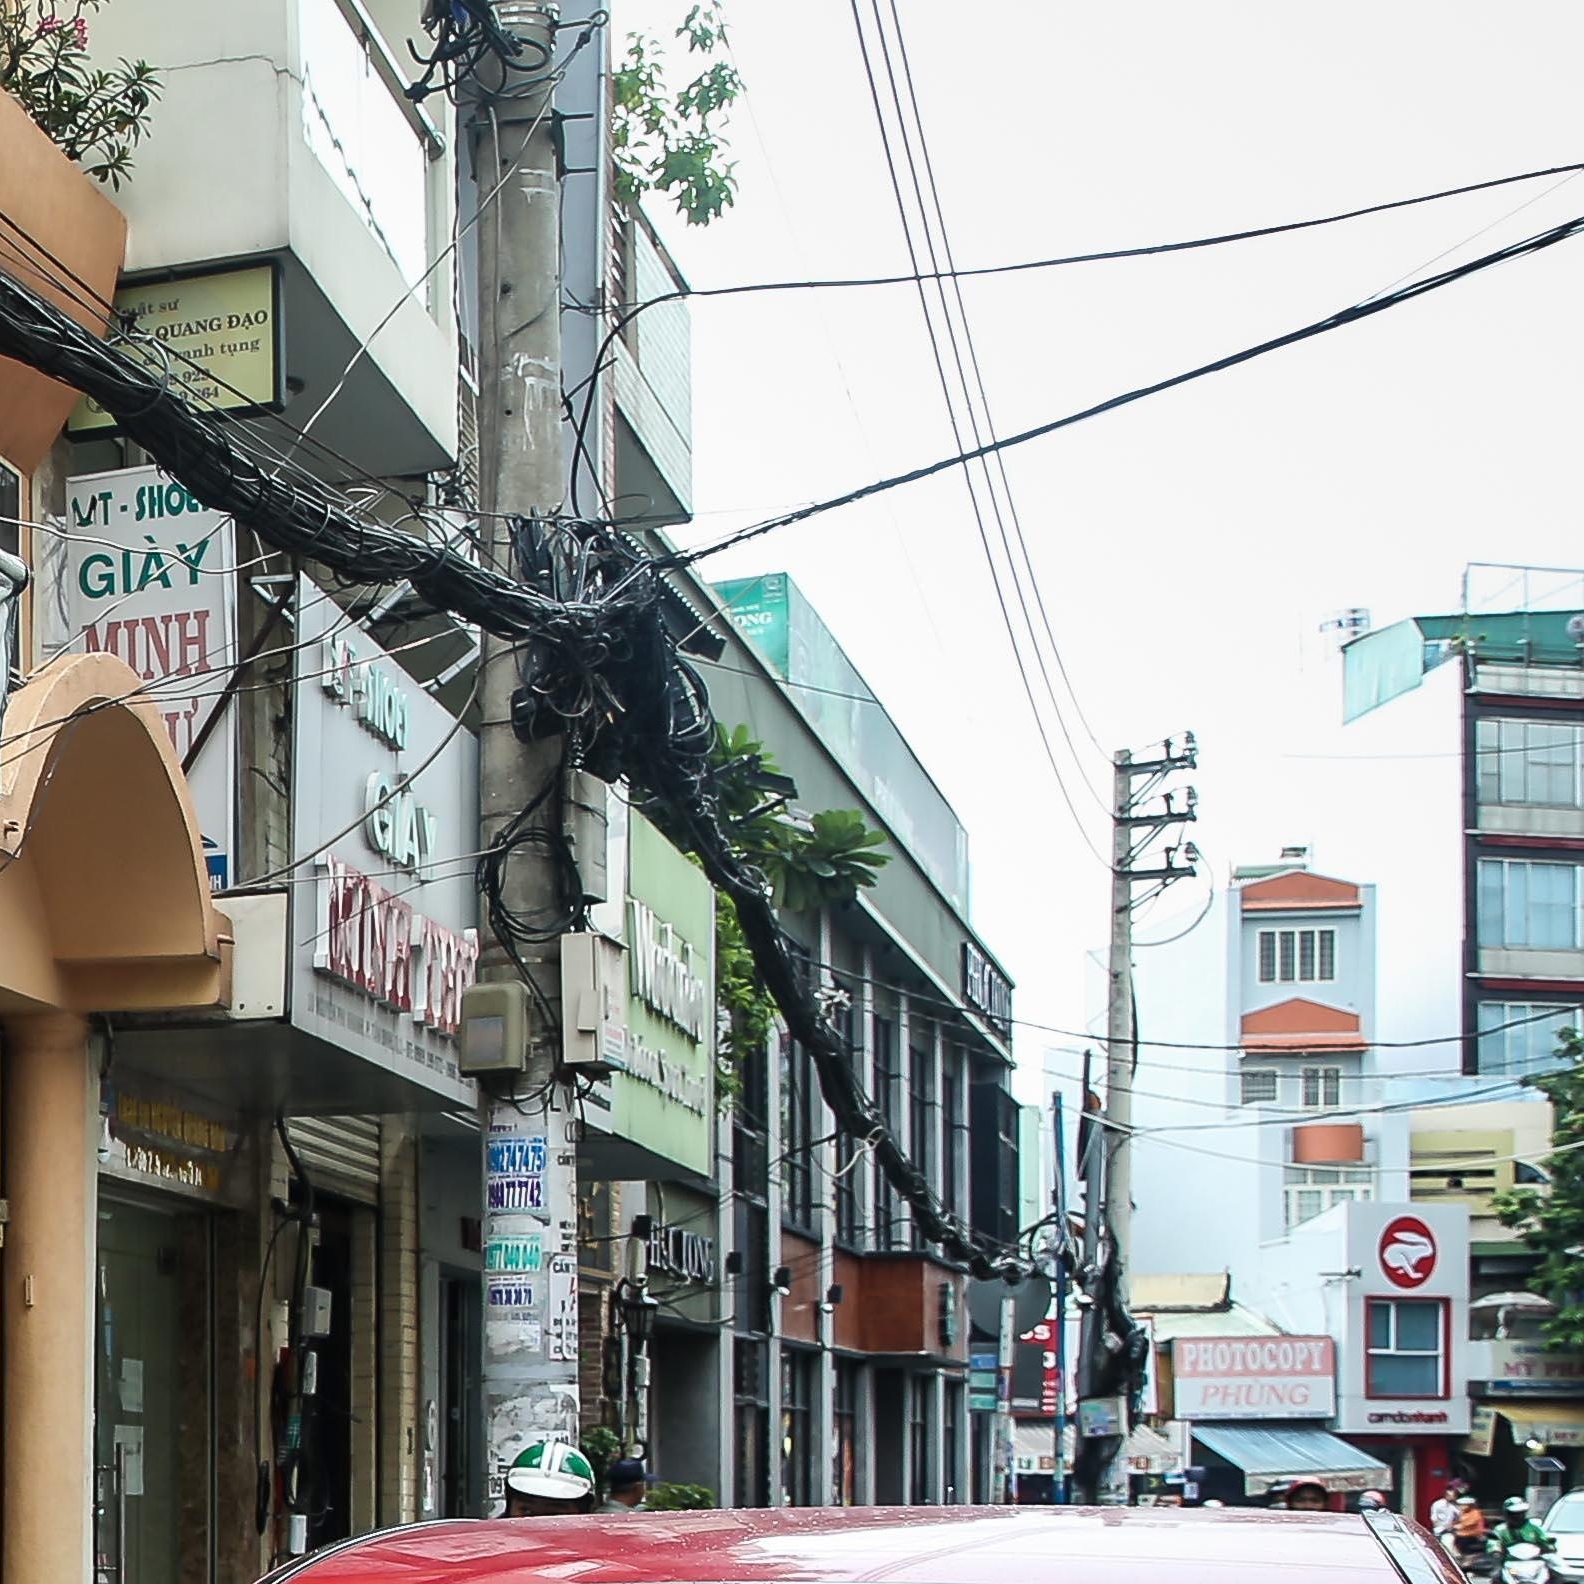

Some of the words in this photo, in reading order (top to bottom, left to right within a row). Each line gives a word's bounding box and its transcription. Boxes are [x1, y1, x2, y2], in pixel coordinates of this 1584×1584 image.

[155, 320, 223, 343] QUANG
[227, 309, 269, 331] ĐẠO
[220, 337, 261, 354] tụng
[78, 534, 210, 600] GIÀY
[1182, 1342, 1325, 1372] PHOTOCOPY
